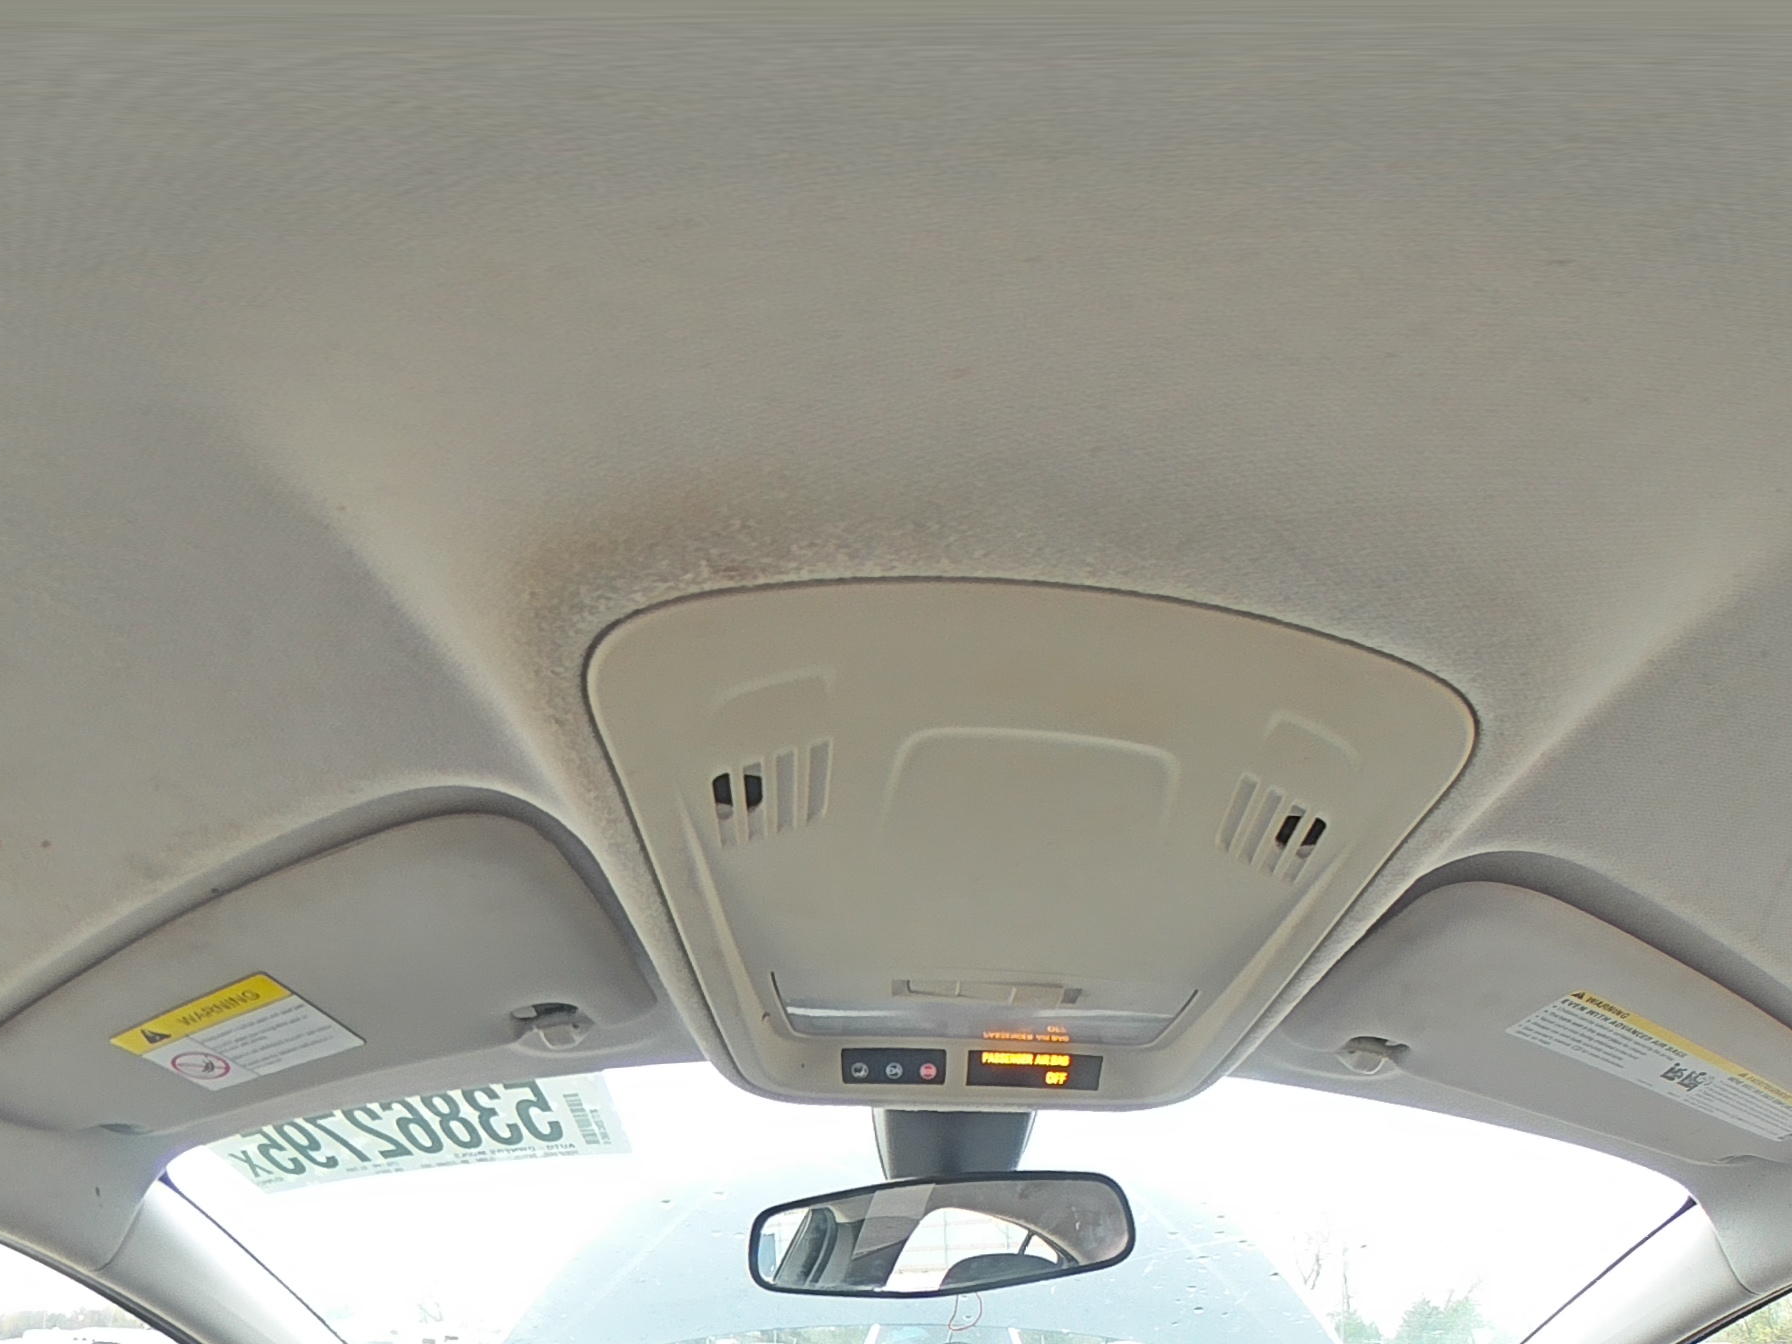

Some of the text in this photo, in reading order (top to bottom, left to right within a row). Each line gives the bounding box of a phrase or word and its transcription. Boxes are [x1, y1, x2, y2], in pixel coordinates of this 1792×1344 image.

[177, 989, 261, 1027] WARNING
[1561, 998, 1587, 1012] EVEN
[1586, 1009, 1612, 1022] WITH
[1609, 1020, 1653, 1040] ADVANCED
[1586, 996, 1630, 1019] WARNING
[982, 1052, 1034, 1065] PASSENGER
[1045, 1071, 1068, 1085] OFF
